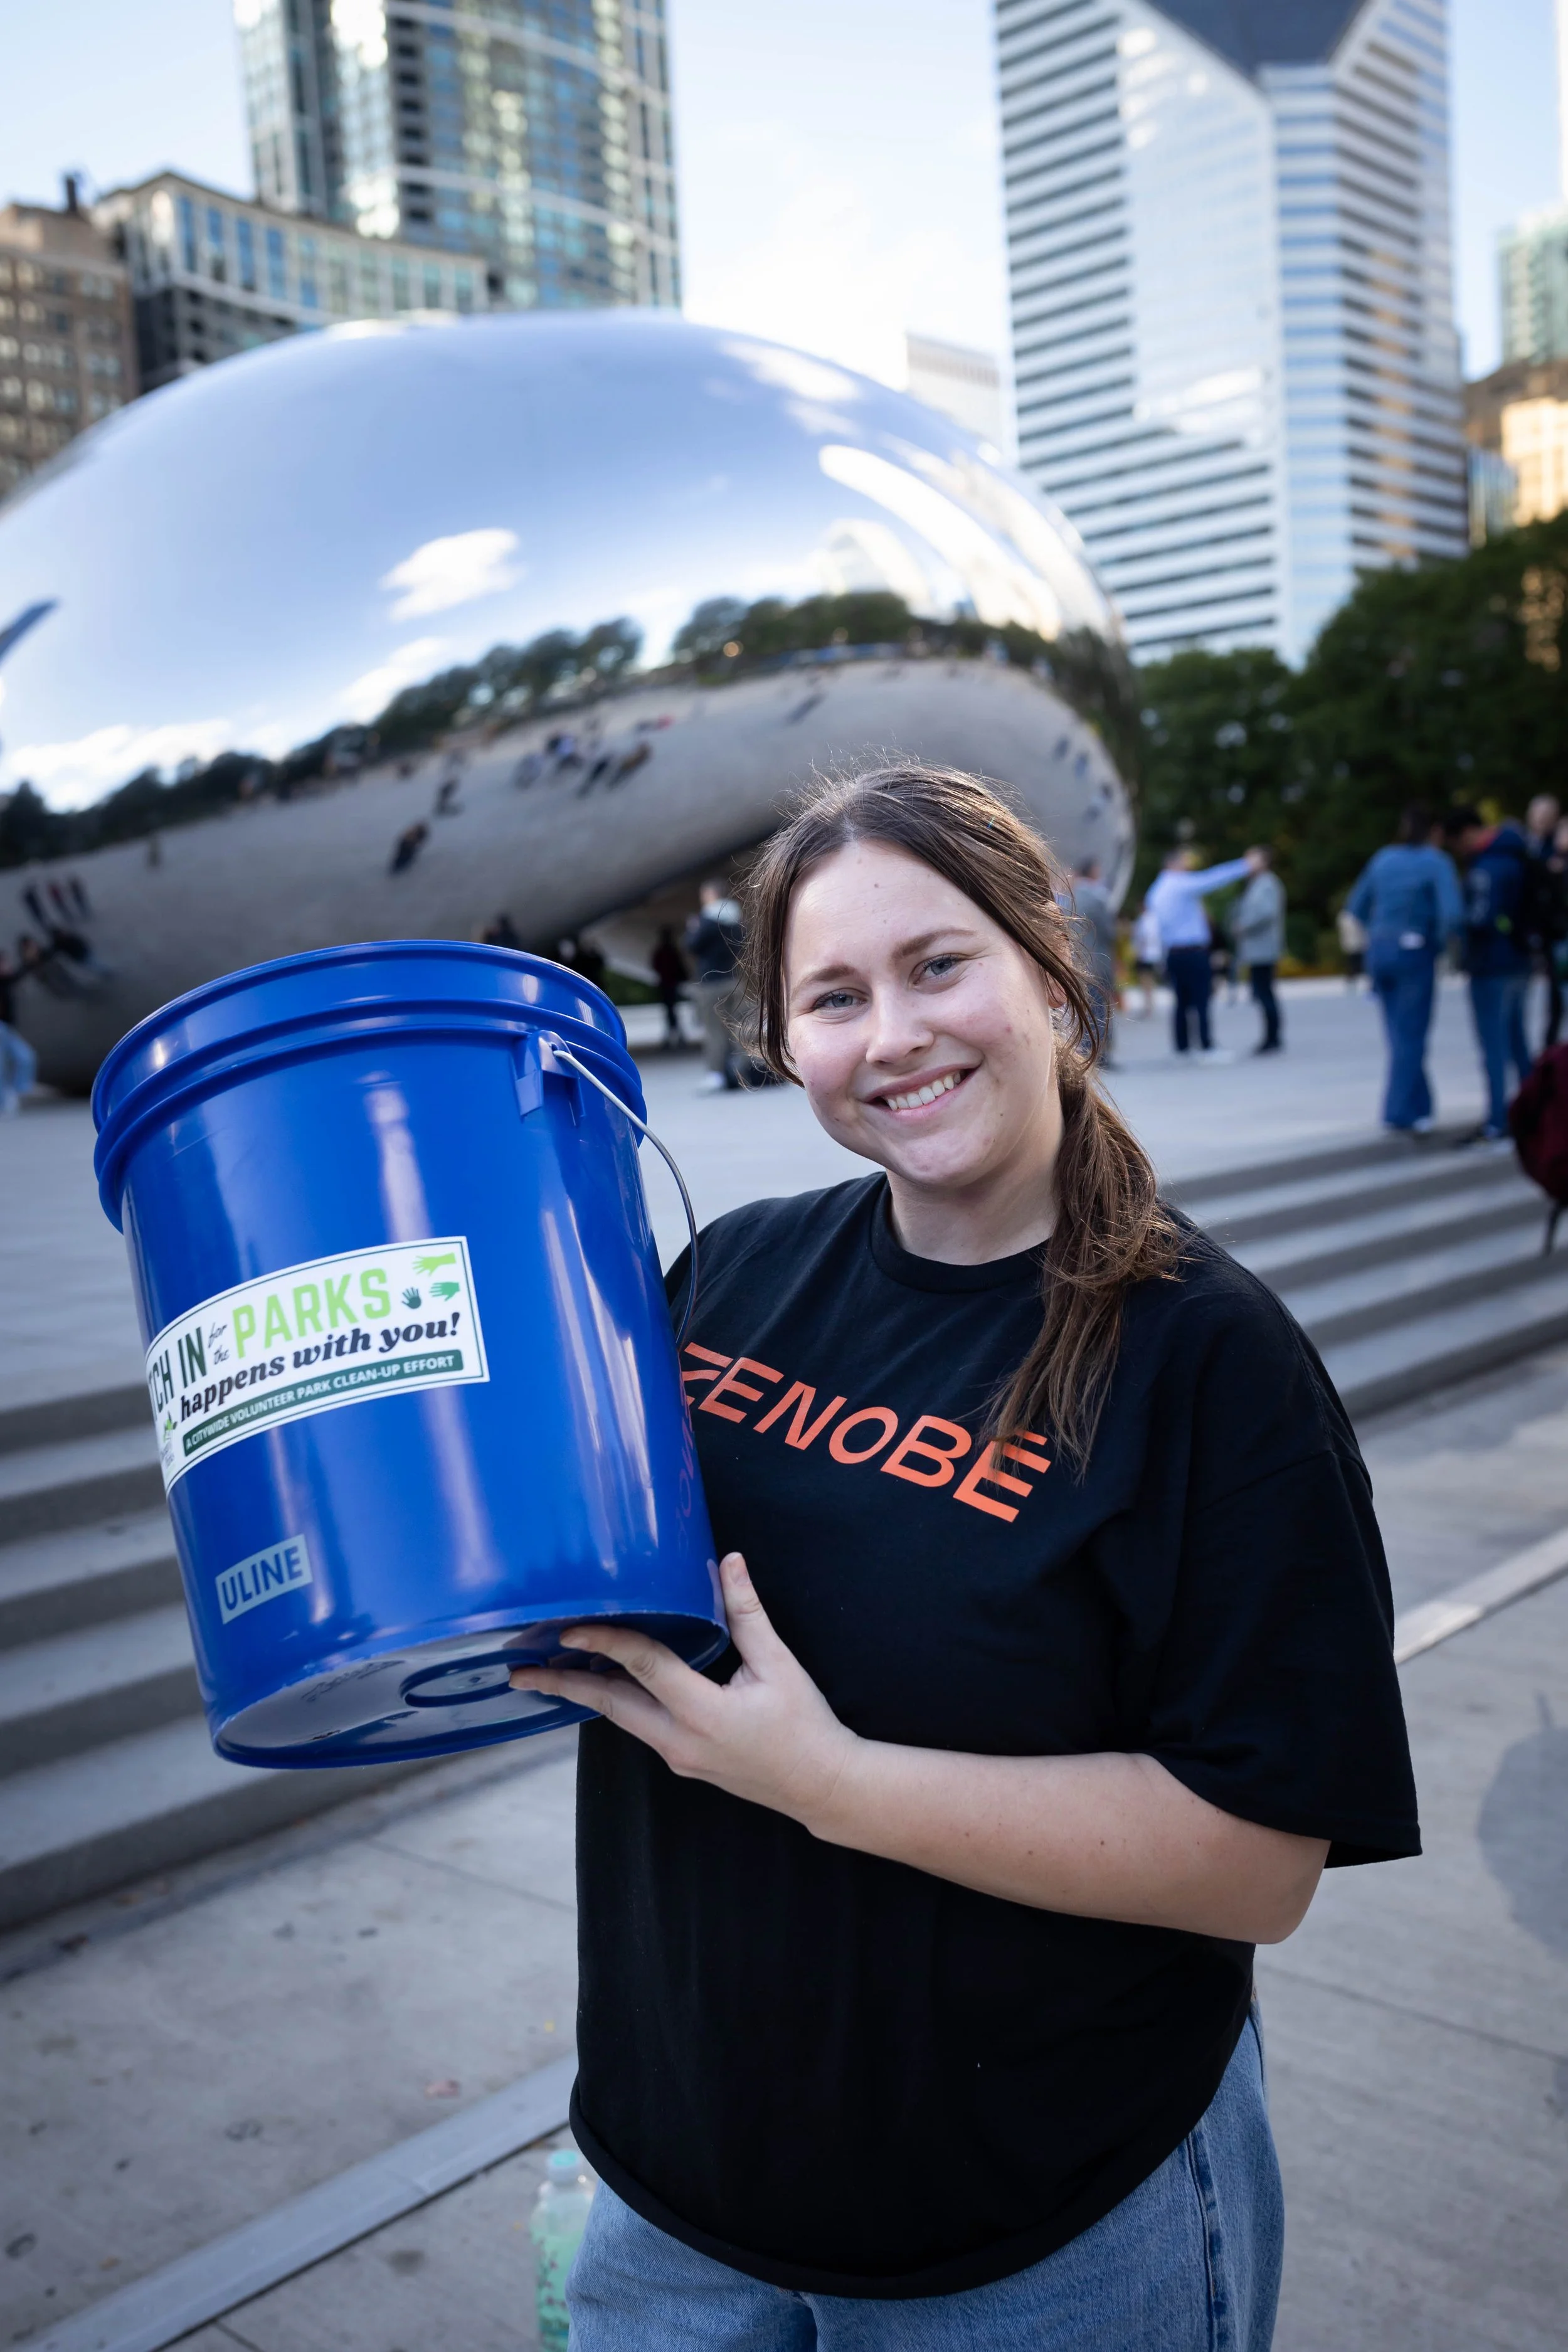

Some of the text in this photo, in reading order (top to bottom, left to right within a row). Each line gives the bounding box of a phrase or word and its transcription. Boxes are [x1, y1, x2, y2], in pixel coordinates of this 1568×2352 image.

[208, 1322, 228, 1348] for
[232, 1268, 391, 1359] PARKS
[177, 1327, 207, 1389] IN
[181, 1312, 461, 1422] happens with you!
[214, 1345, 230, 1365] the
[186, 1355, 455, 1450] A CITYWIDE VOLUNTEER PARK CLEAN-UP EFFORT
[221, 1545, 304, 1611] ULINE
